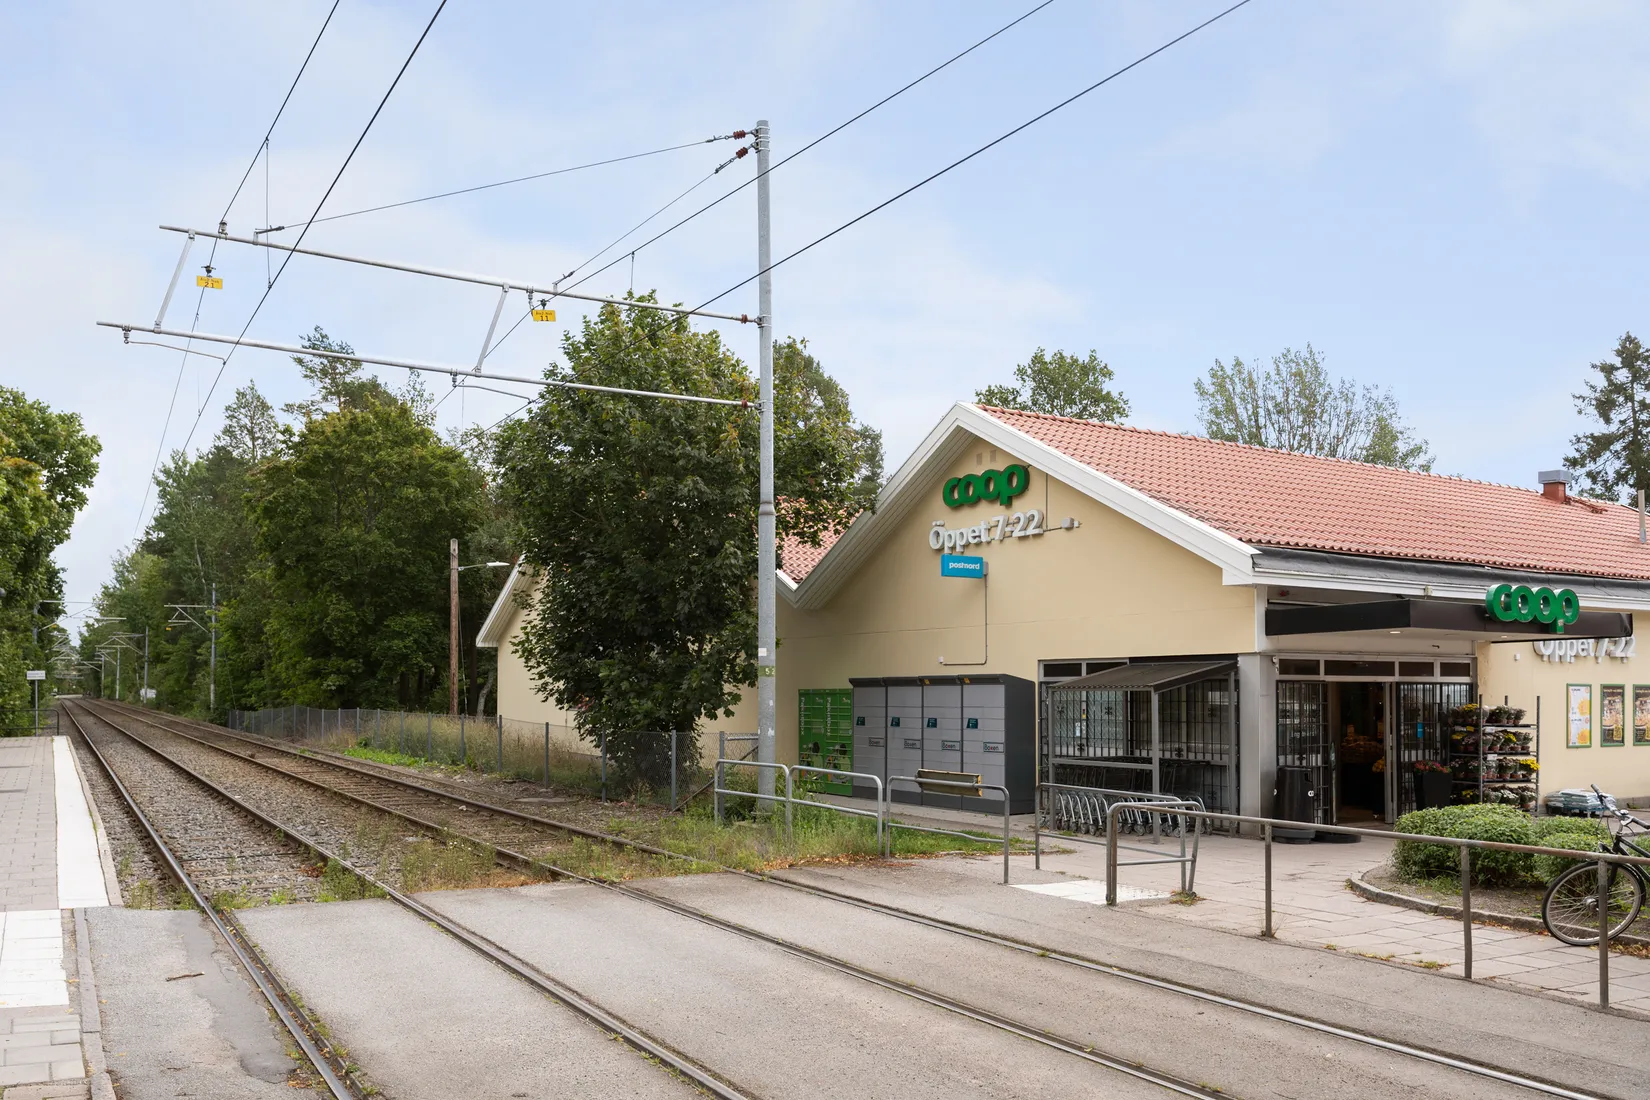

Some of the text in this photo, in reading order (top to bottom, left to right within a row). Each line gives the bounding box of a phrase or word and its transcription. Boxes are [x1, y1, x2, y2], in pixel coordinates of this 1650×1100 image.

[943, 464, 1030, 508] coop
[929, 509, 1044, 554] Öppet 7-22
[949, 561, 980, 570] postnord
[1486, 584, 1580, 634] coop
